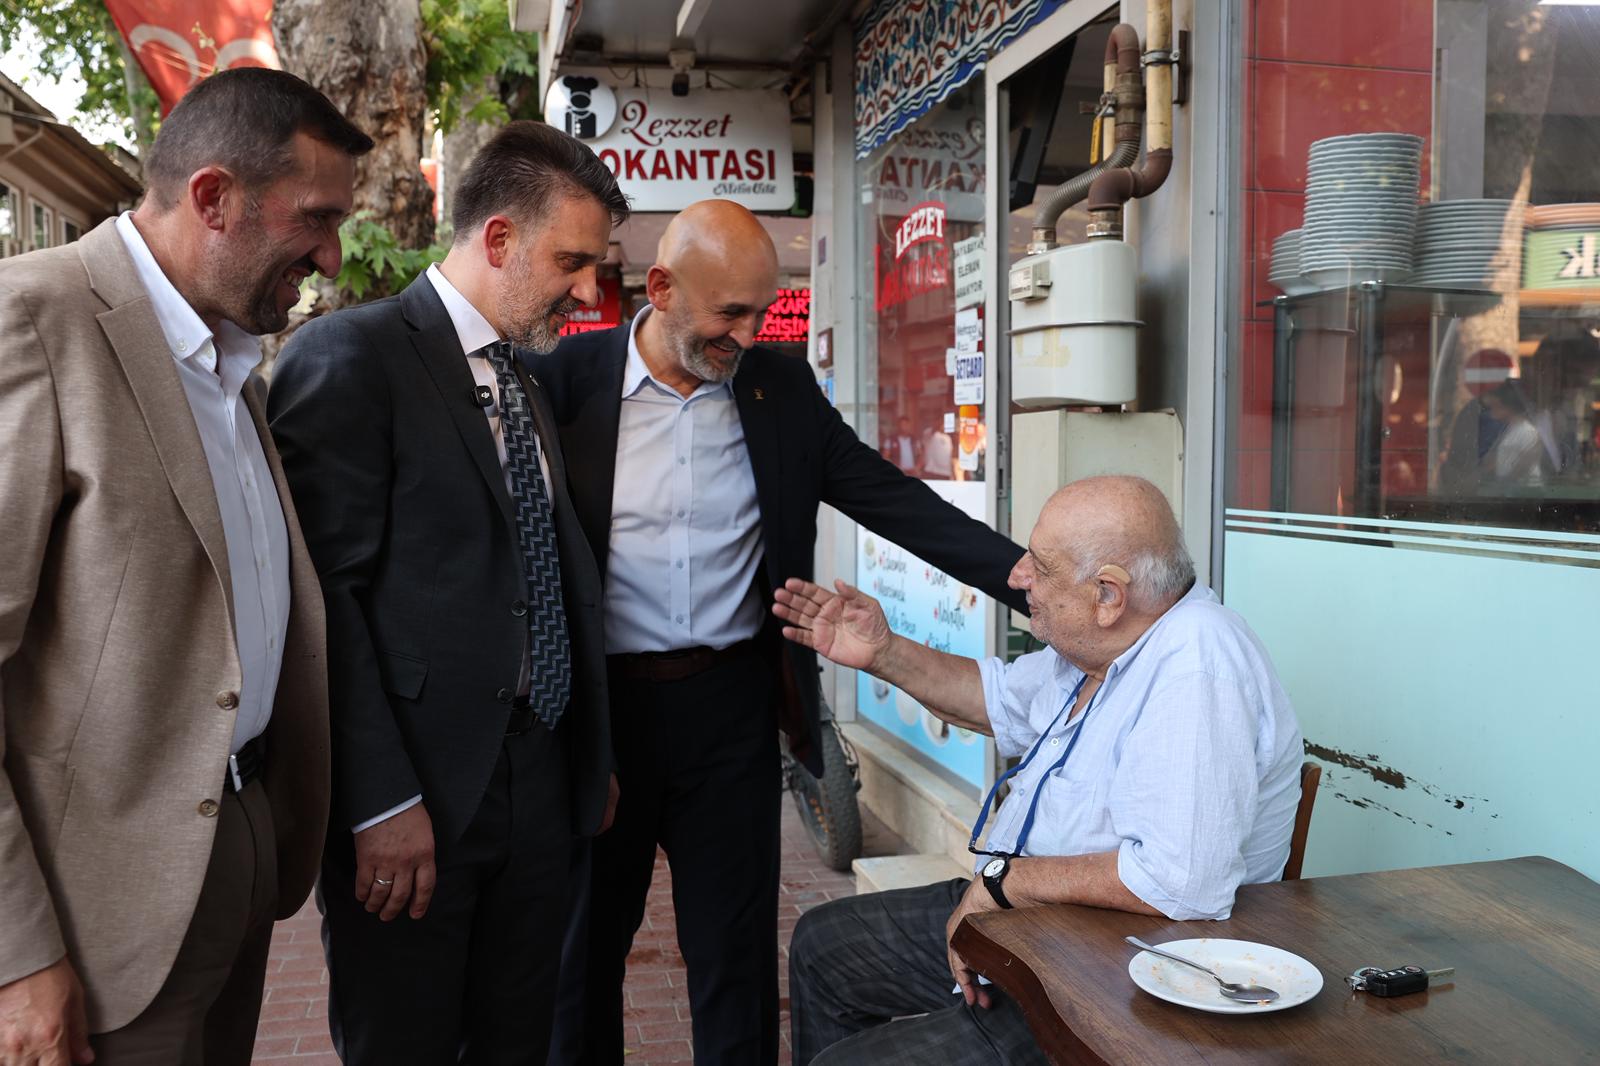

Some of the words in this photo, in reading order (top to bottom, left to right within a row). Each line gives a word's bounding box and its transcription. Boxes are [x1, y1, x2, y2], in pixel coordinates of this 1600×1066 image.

[621, 100, 733, 146] Lezzet
[600, 148, 776, 181] OKANTASI
[896, 206, 945, 259] LEZZET
